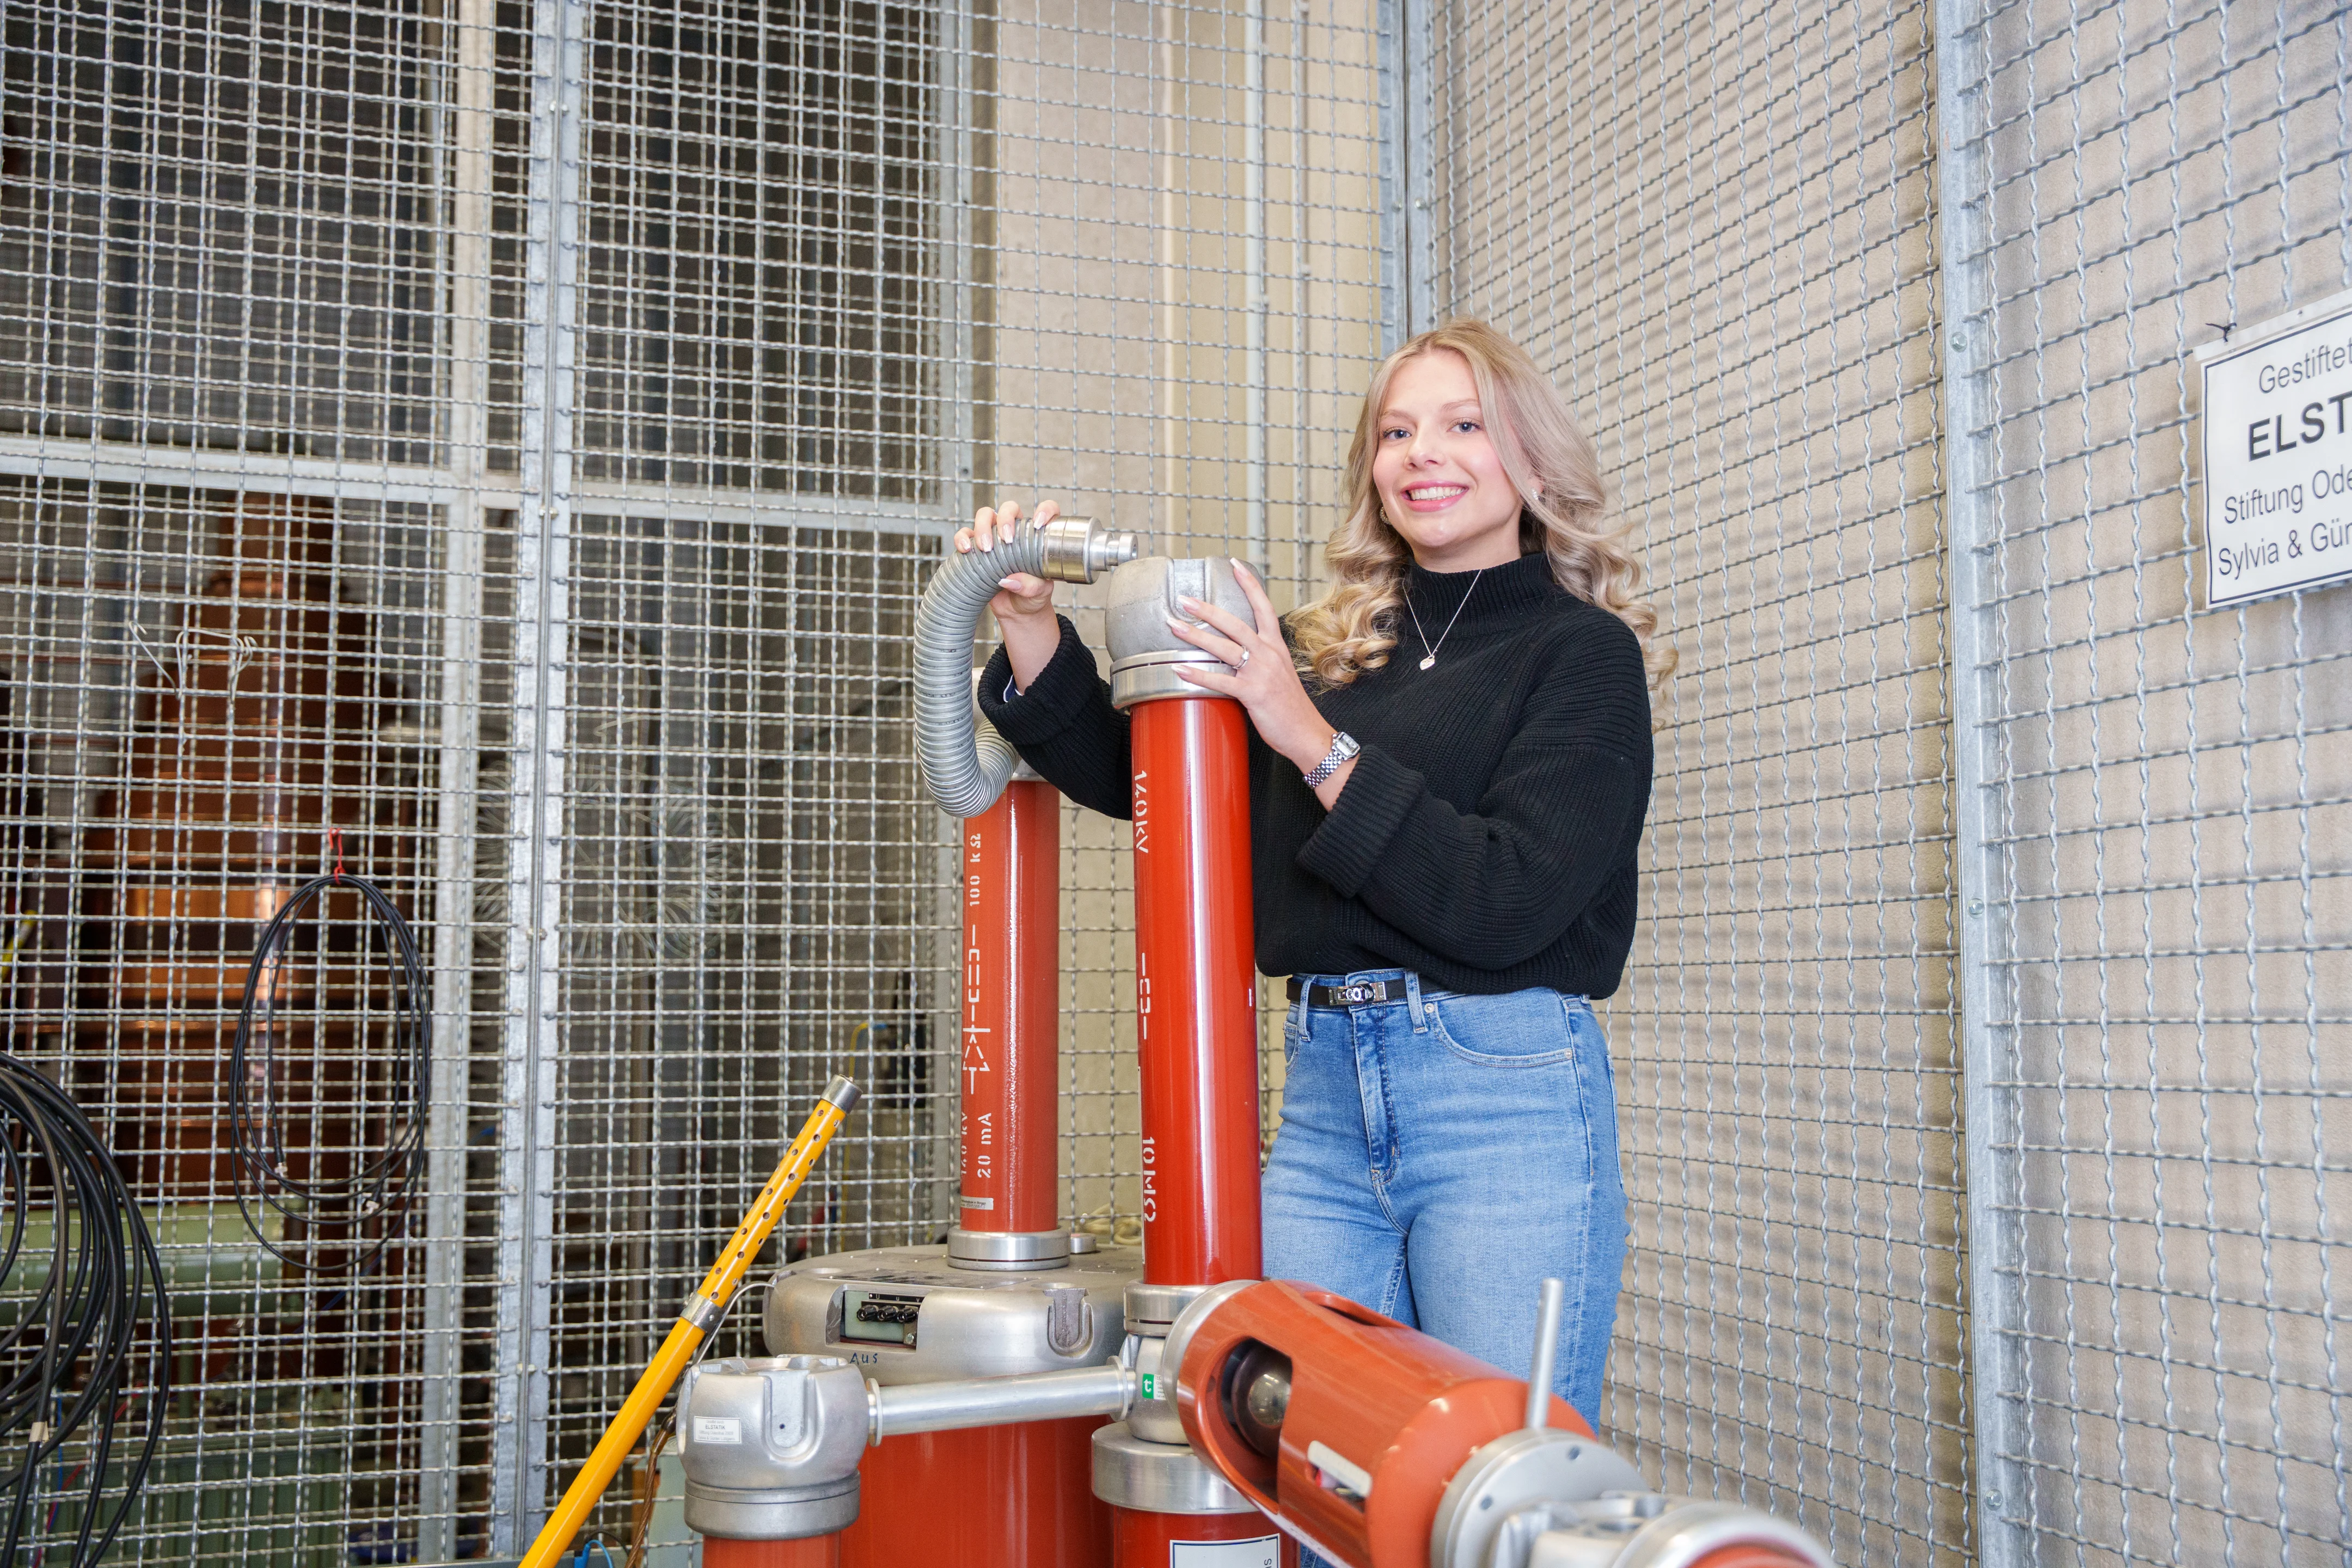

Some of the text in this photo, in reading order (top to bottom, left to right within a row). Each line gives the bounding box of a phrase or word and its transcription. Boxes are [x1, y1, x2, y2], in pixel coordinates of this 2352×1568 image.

[2248, 390, 2352, 462] ELST
[2224, 483, 2304, 524] Stiftung
[2218, 537, 2280, 580] Sylvia
[2287, 529, 2304, 560] &
[970, 875, 980, 906] 100
[977, 1113, 991, 1178] 20 mA
[1142, 1136, 1155, 1163] 10
